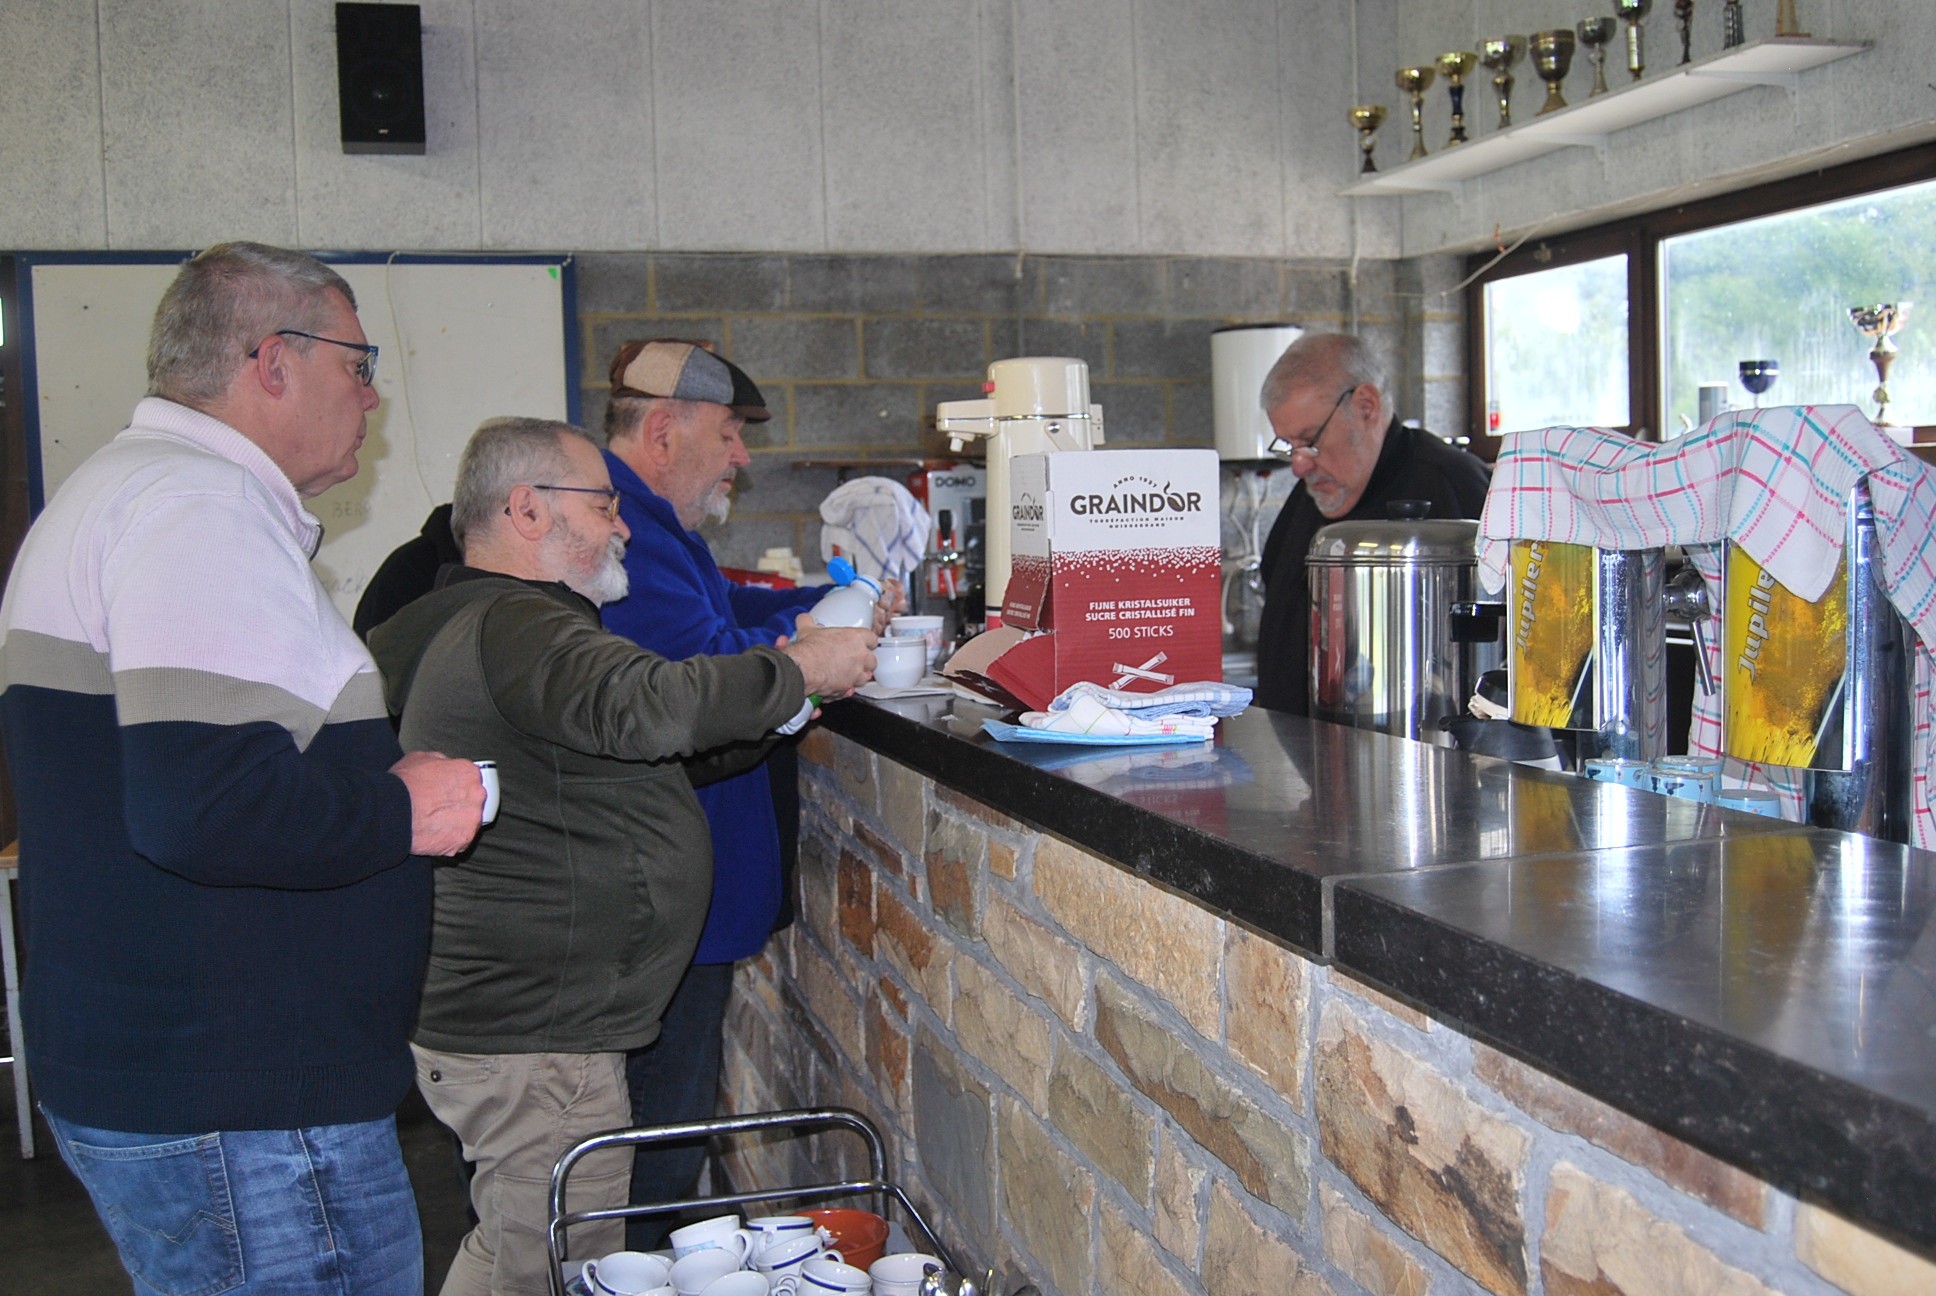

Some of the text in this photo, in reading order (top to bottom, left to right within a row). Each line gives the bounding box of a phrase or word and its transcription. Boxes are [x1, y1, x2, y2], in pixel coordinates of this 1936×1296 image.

[935, 476, 976, 488] DOMO
[1113, 475, 1135, 489] ANNO
[1089, 598, 1191, 611] FIJNE KRISTALSUIKER
[1516, 539, 1544, 660] Jupiler
[1085, 608, 1195, 621] SUCRE CRISTALLISÉ FIN
[1108, 625, 1174, 639] 500 STICKS
[1738, 566, 1776, 686] Jupile
